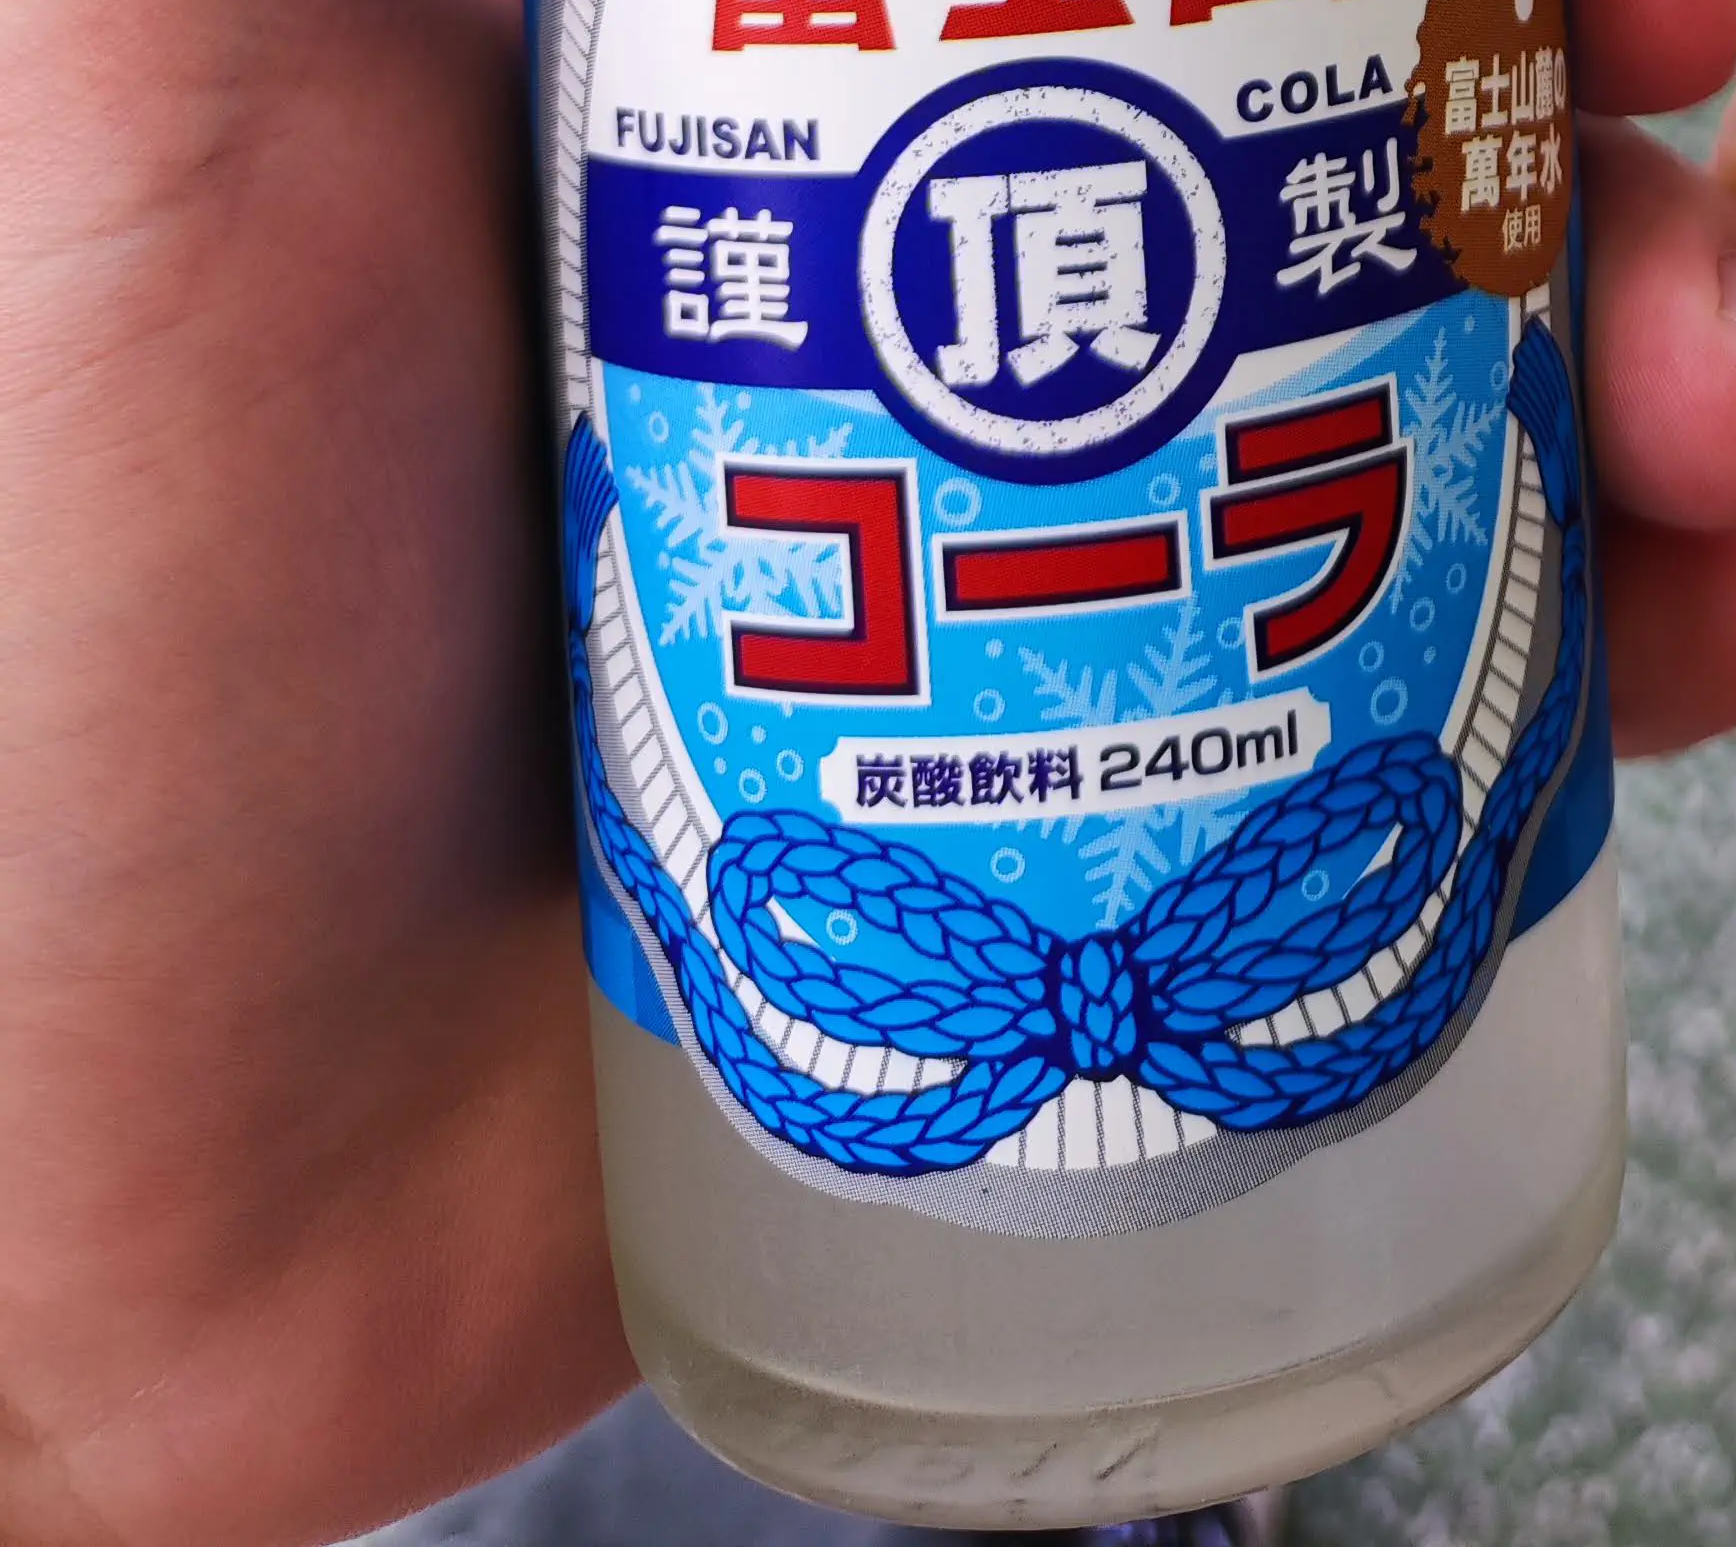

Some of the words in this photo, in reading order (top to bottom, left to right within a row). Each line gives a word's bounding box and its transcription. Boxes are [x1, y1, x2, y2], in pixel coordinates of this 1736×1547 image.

[1236, 54, 1393, 124] COLA
[614, 108, 820, 164] FUJISAN
[1461, 124, 1564, 213] 萬年水
[656, 206, 809, 355] 謹
[927, 159, 1163, 387] 頂
[1274, 137, 1418, 296] 製
[1502, 204, 1542, 253] 使用
[722, 374, 1413, 707] コーラ
[854, 750, 1082, 812] 炭酸飲料
[1099, 711, 1298, 791] 240ml
